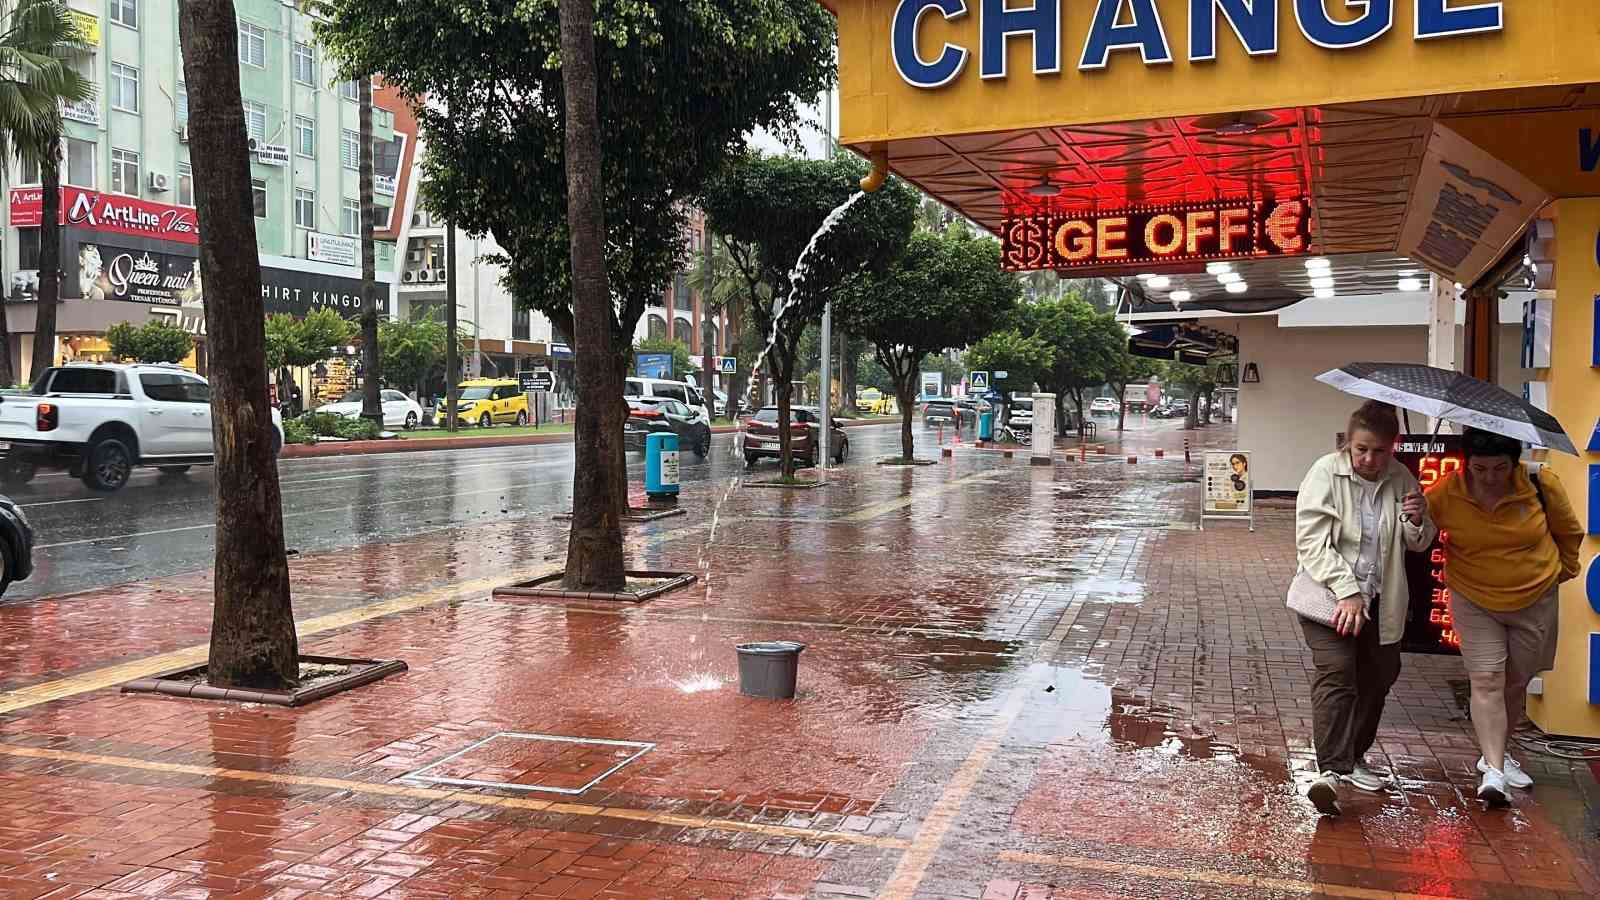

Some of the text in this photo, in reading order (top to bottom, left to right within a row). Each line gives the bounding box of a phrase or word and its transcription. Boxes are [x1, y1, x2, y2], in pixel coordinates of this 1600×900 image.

[102, 202, 160, 226] ArtLine
[161, 210, 193, 232] Vize
[1055, 217, 1128, 260] GE
[1145, 208, 1249, 254] OFF
[109, 253, 193, 296] Queen nail
[261, 284, 384, 311] HIRT KINGDM
